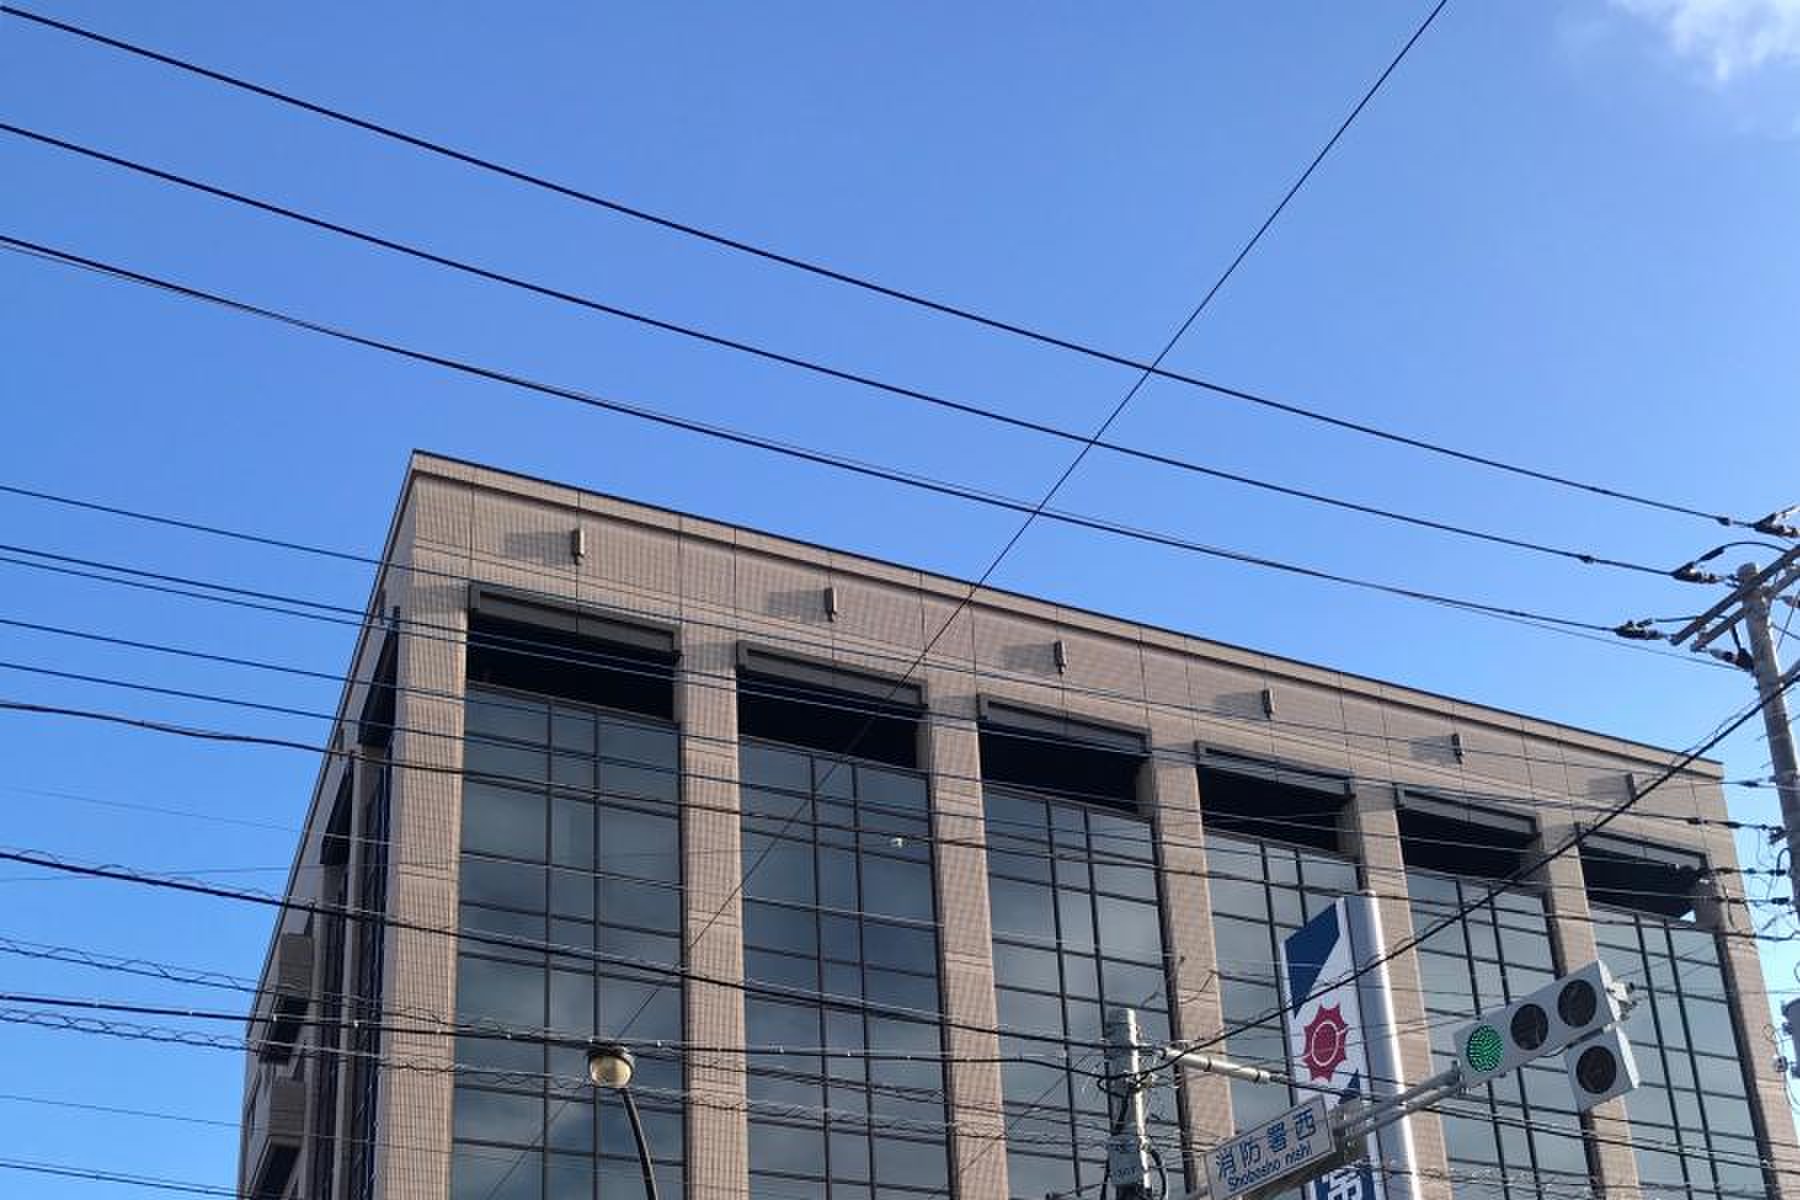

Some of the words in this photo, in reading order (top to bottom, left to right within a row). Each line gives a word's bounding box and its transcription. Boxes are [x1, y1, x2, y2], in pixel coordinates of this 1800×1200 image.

[1215, 1107, 1316, 1182] 消防署西
[1285, 1140, 1313, 1166] nishi
